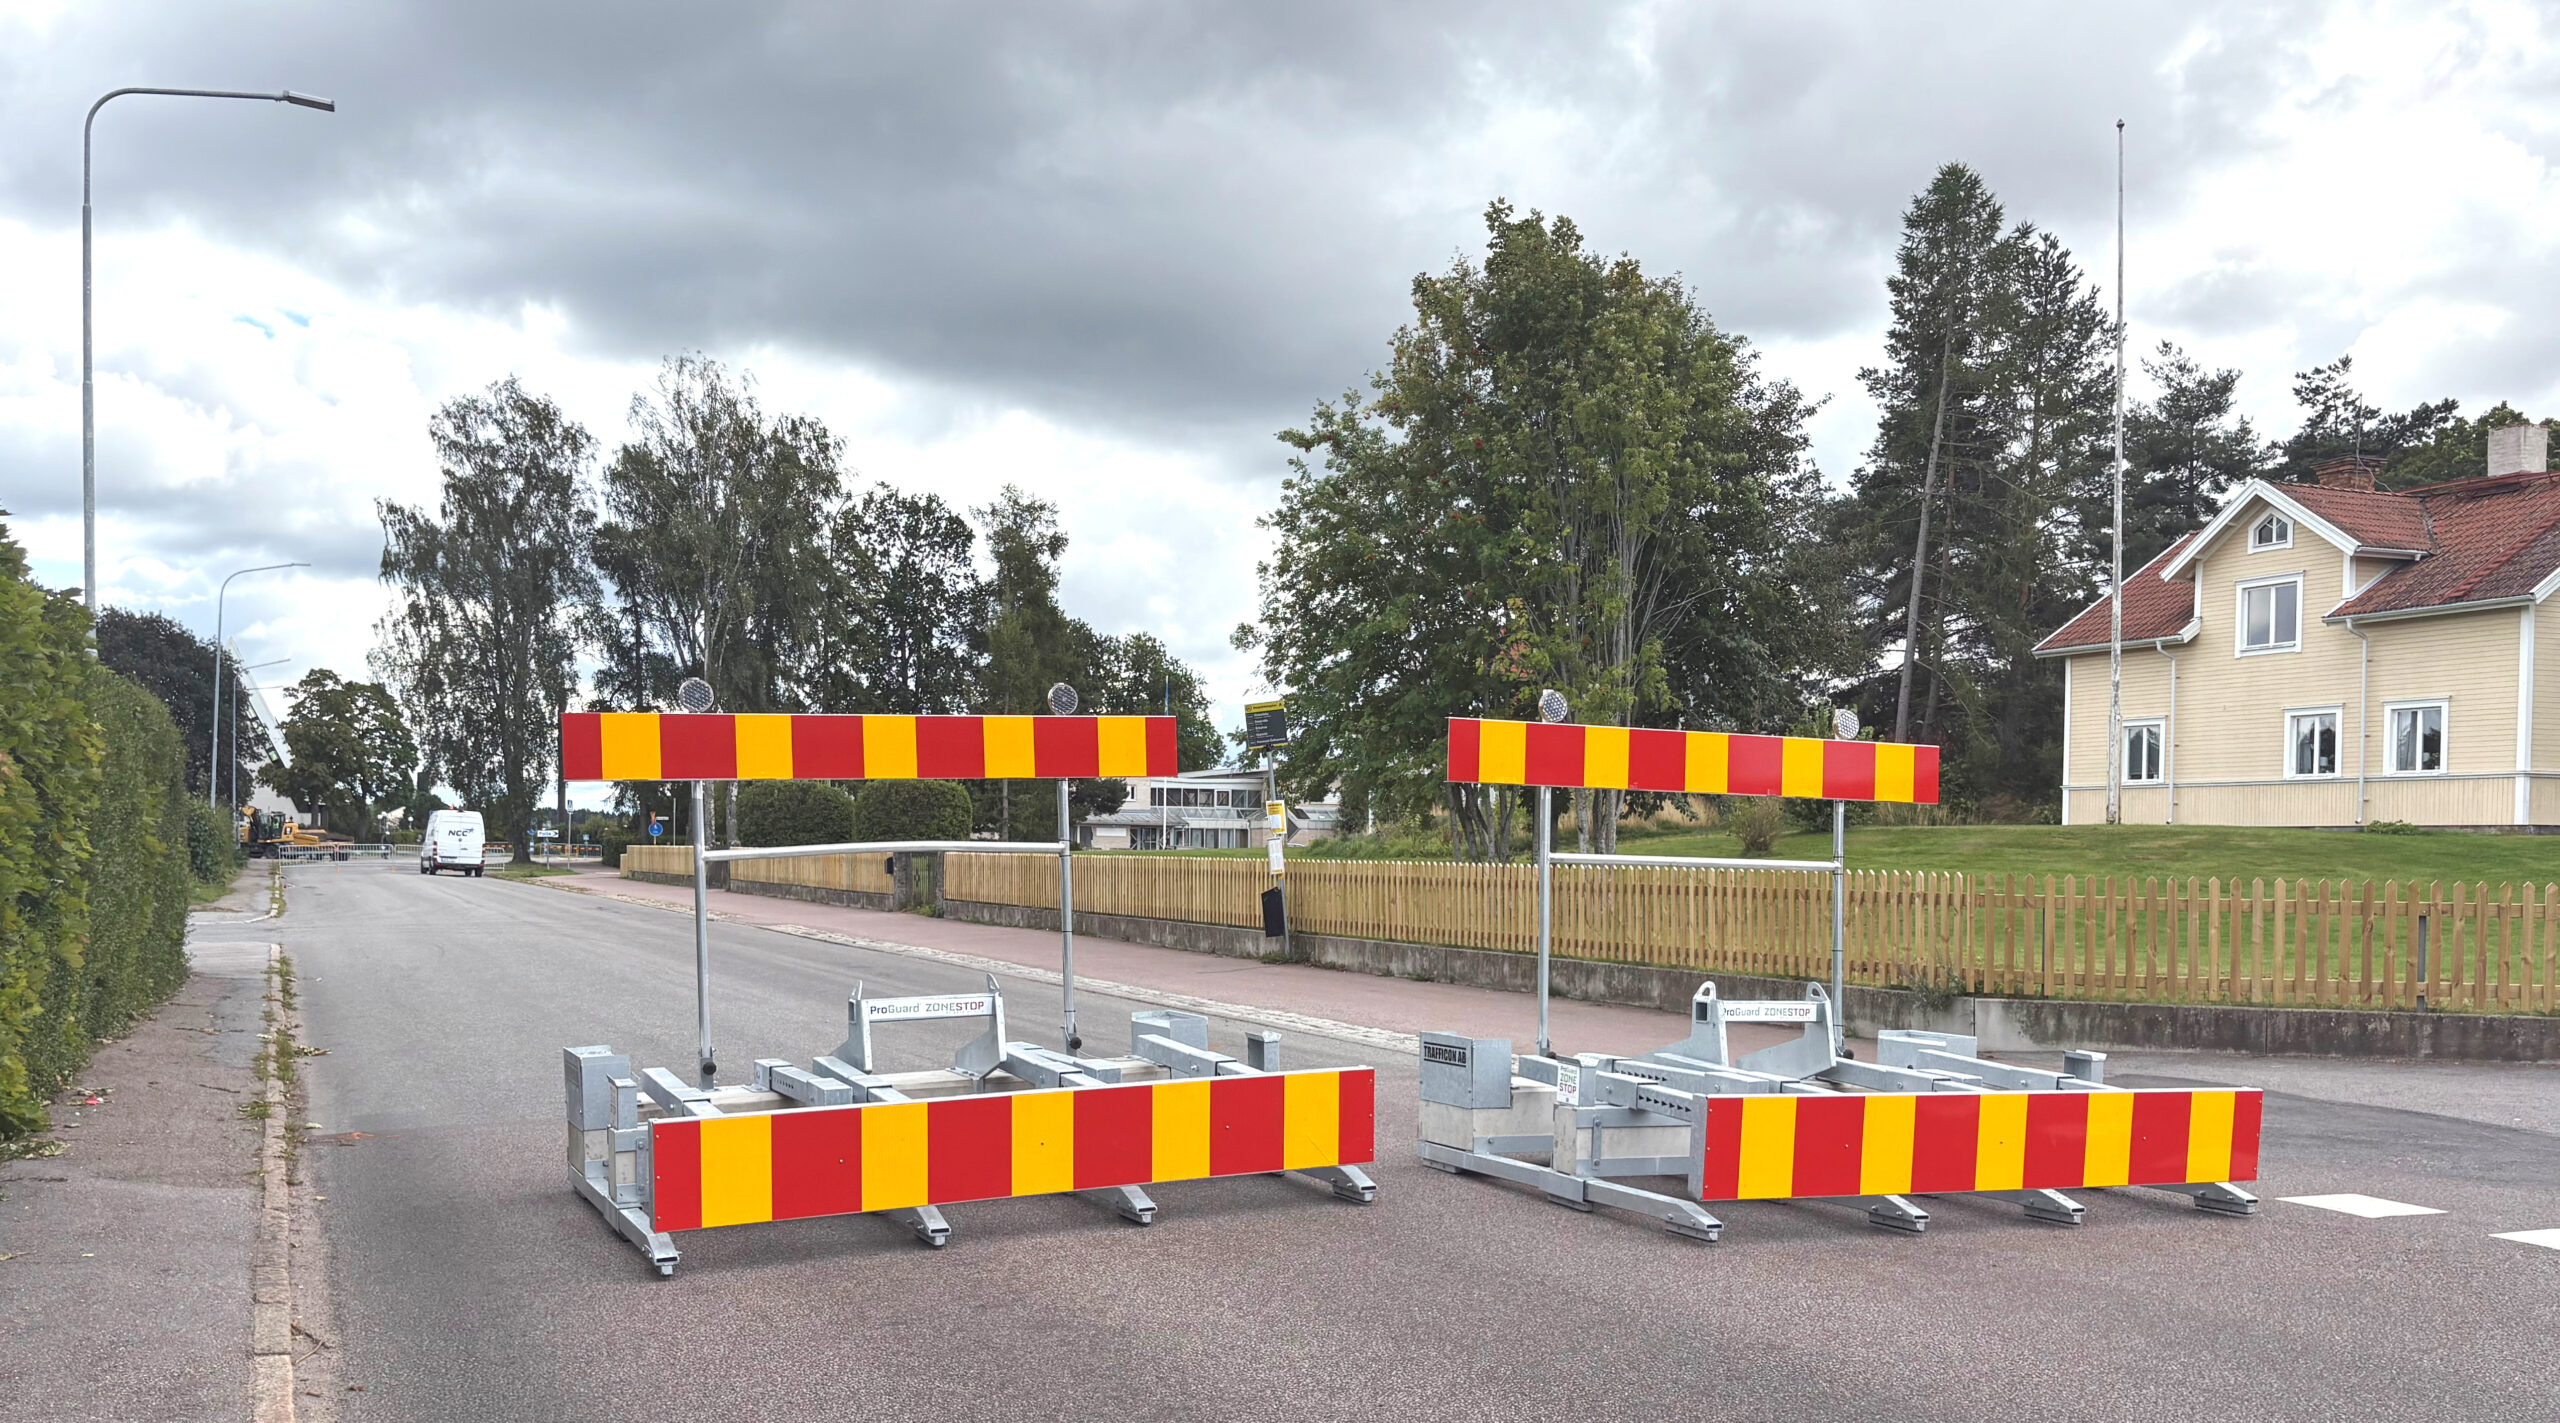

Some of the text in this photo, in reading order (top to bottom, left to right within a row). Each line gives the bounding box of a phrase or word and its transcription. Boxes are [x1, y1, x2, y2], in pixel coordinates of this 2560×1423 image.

[870, 1001, 985, 1015] ProGuard ZONESTOP
[1764, 1007, 1811, 1017] ZONESTOP
[1424, 1046, 1467, 1064] TRAFFICON AB
[1560, 1073, 1578, 1085] ZONE
[1559, 1082, 1577, 1094] STOP
